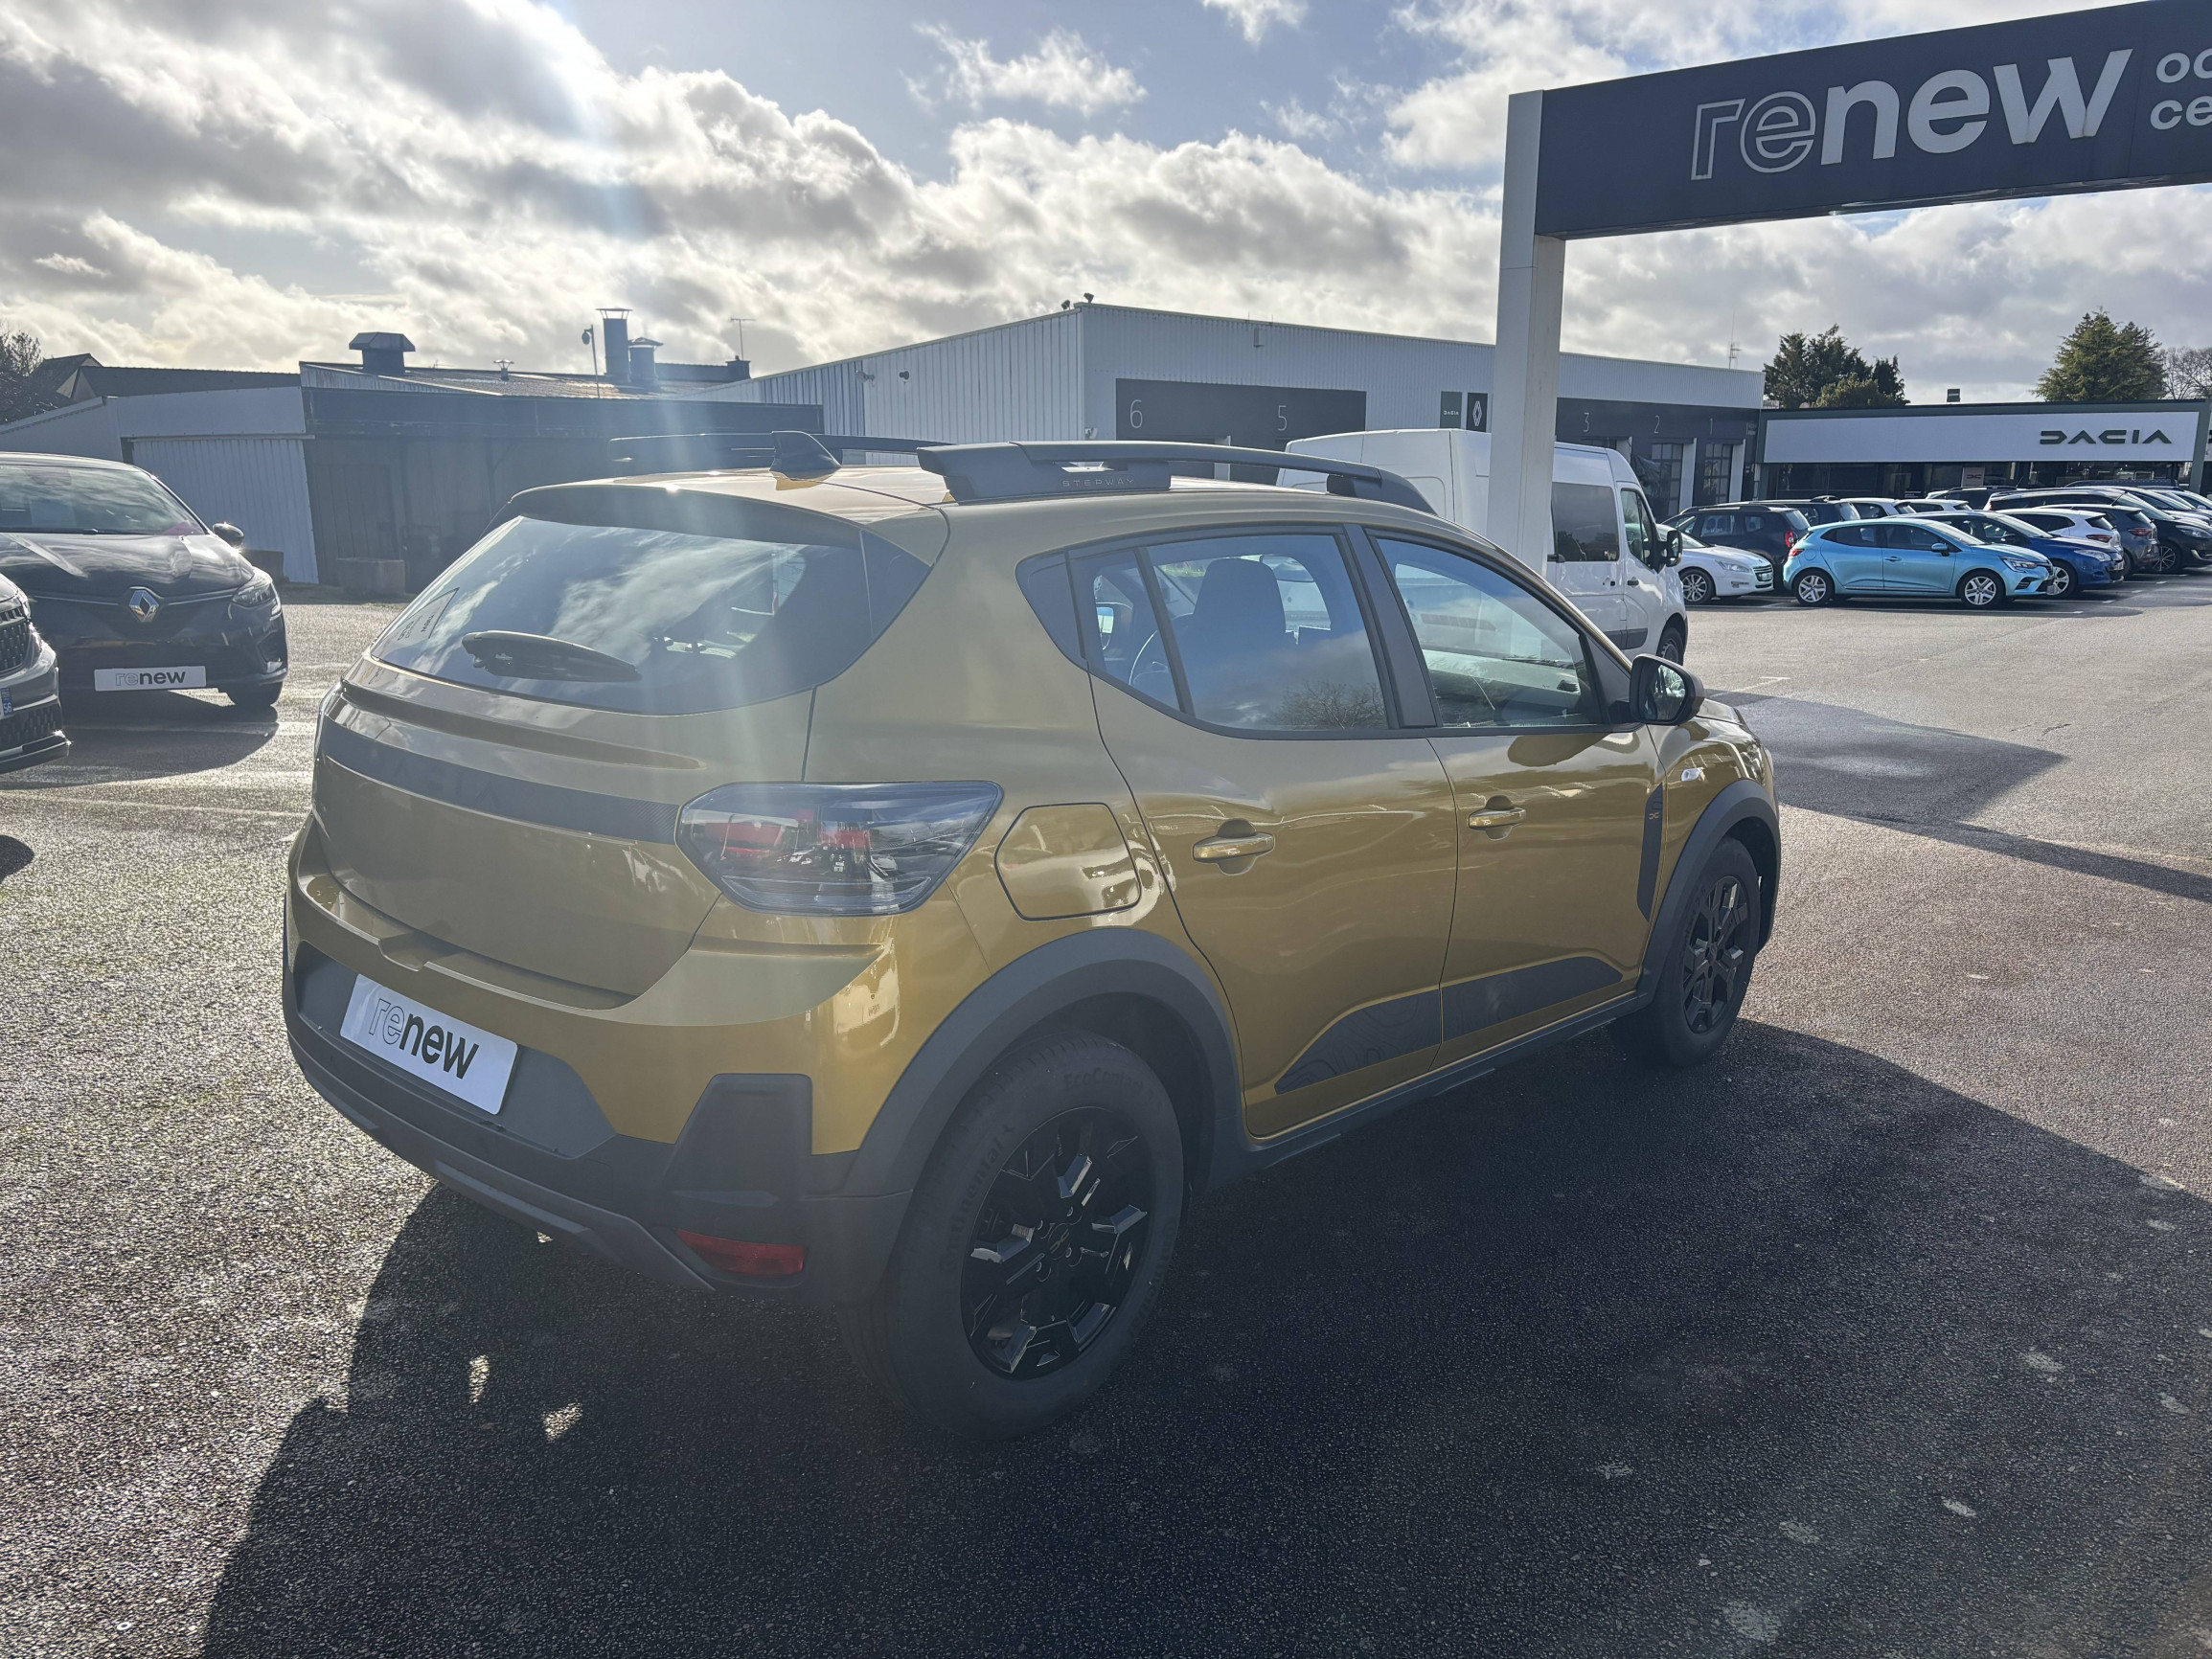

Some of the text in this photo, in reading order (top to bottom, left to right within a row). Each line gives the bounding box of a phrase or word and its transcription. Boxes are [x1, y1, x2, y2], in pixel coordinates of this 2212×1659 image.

[1690, 48, 2133, 181] renew
[1129, 398, 1144, 429] 6
[1277, 404, 1288, 431] 5
[1583, 412, 1590, 433] 3
[1653, 415, 1661, 434] 2
[1709, 417, 1714, 435] 1
[2040, 429, 2173, 444] DACIA
[1061, 478, 1134, 488] STEPWAY
[115, 671, 186, 687] renew
[3, 702, 12, 714] 56
[368, 997, 480, 1079] renew
